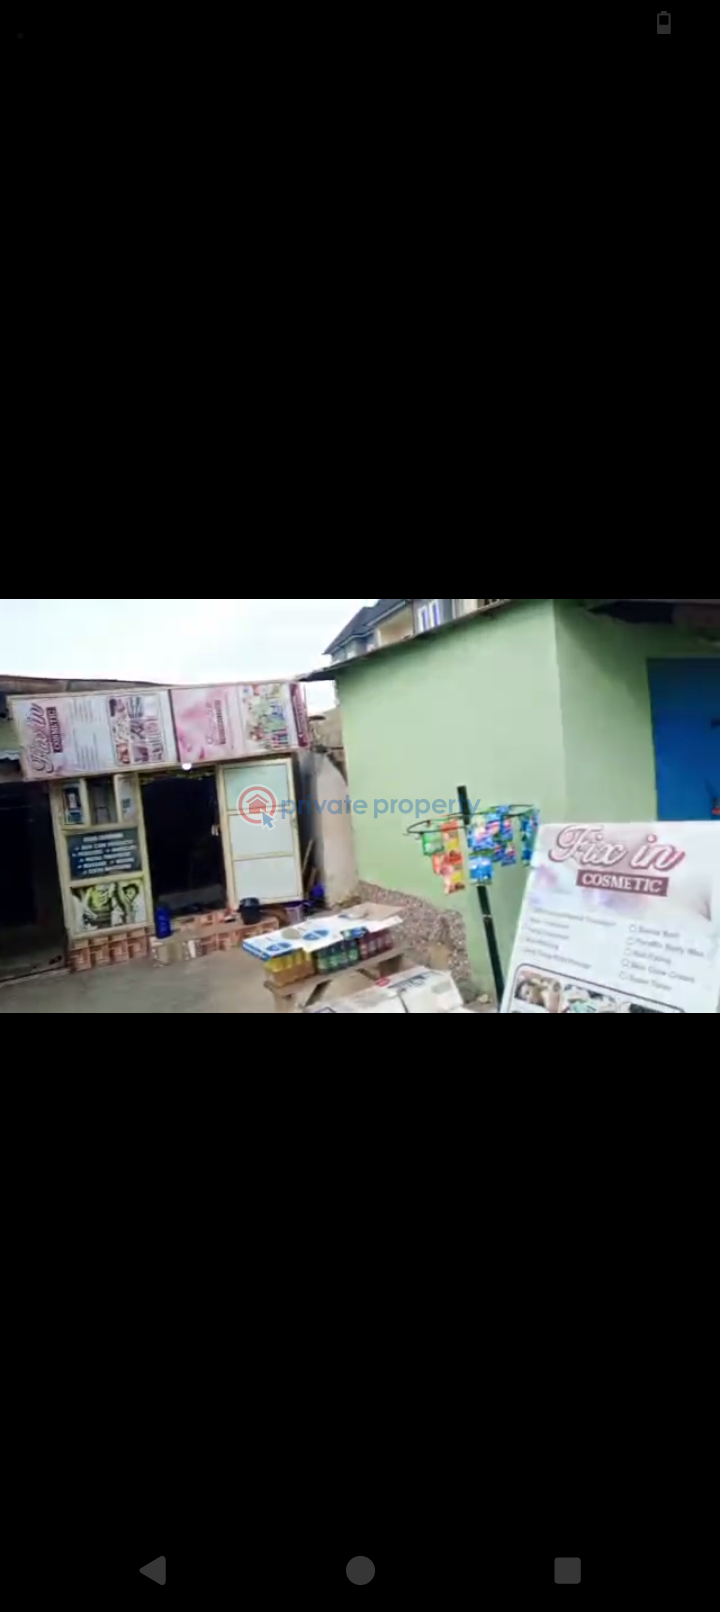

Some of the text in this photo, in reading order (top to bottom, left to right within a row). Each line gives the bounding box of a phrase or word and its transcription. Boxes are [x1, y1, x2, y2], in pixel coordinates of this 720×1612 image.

[549, 824, 686, 871] Fix in
[581, 872, 663, 893] COSMETIC
